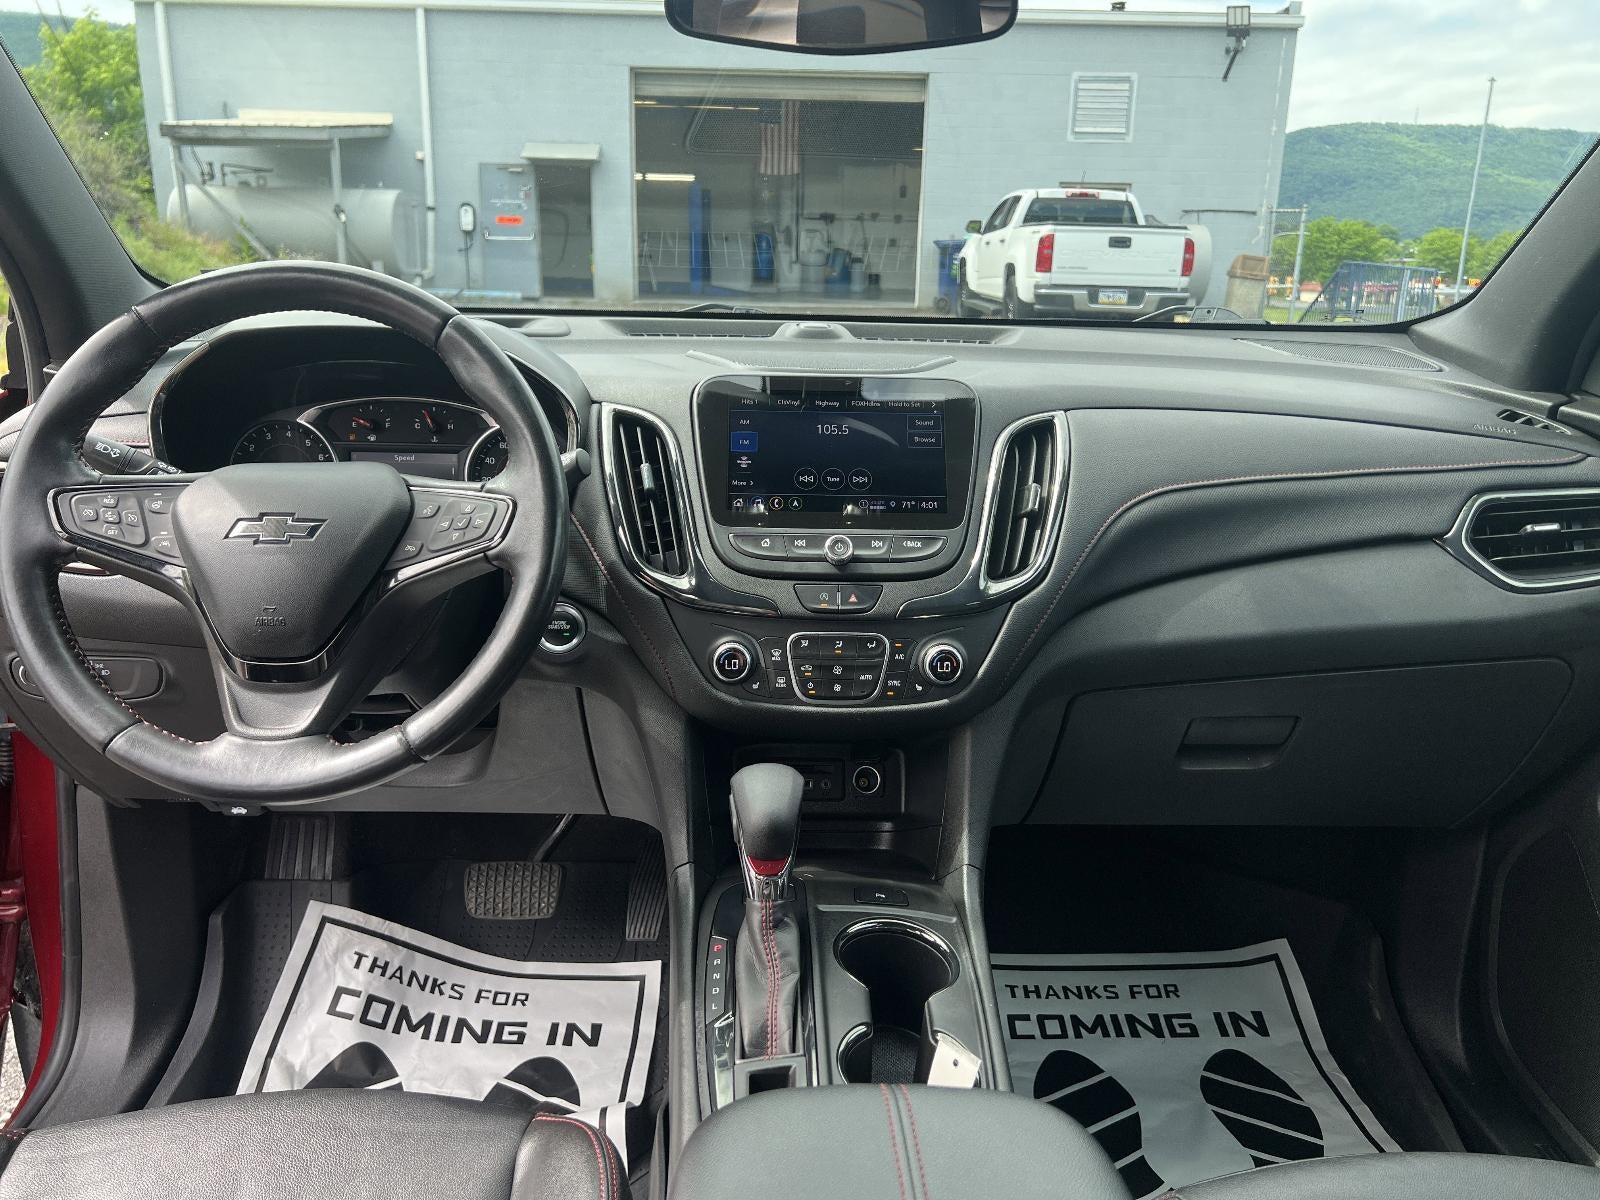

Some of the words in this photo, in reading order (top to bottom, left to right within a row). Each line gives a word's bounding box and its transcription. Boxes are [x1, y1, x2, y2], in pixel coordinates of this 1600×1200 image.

[815, 400, 840, 408] Highway
[816, 424, 849, 435] 105.5
[266, 432, 272, 440] 3
[285, 430, 291, 438] 4
[305, 439, 311, 447] 5
[249, 444, 255, 452] 2
[394, 454, 415, 462] Speed
[485, 457, 495, 465] 40
[920, 501, 938, 509] 4:01
[725, 659, 739, 670] LO
[937, 661, 951, 672] LO
[353, 950, 466, 1001] THANKS
[474, 988, 531, 1008] FOR
[713, 972, 721, 980] N
[712, 987, 720, 995] D
[1004, 983, 1119, 1000] THANKS
[1129, 983, 1181, 999] FOR
[711, 1002, 718, 1010] L
[325, 985, 529, 1046] COMING
[545, 1021, 603, 1048] IN
[1006, 1012, 1201, 1041] COMING
[1211, 1010, 1271, 1039] IN
